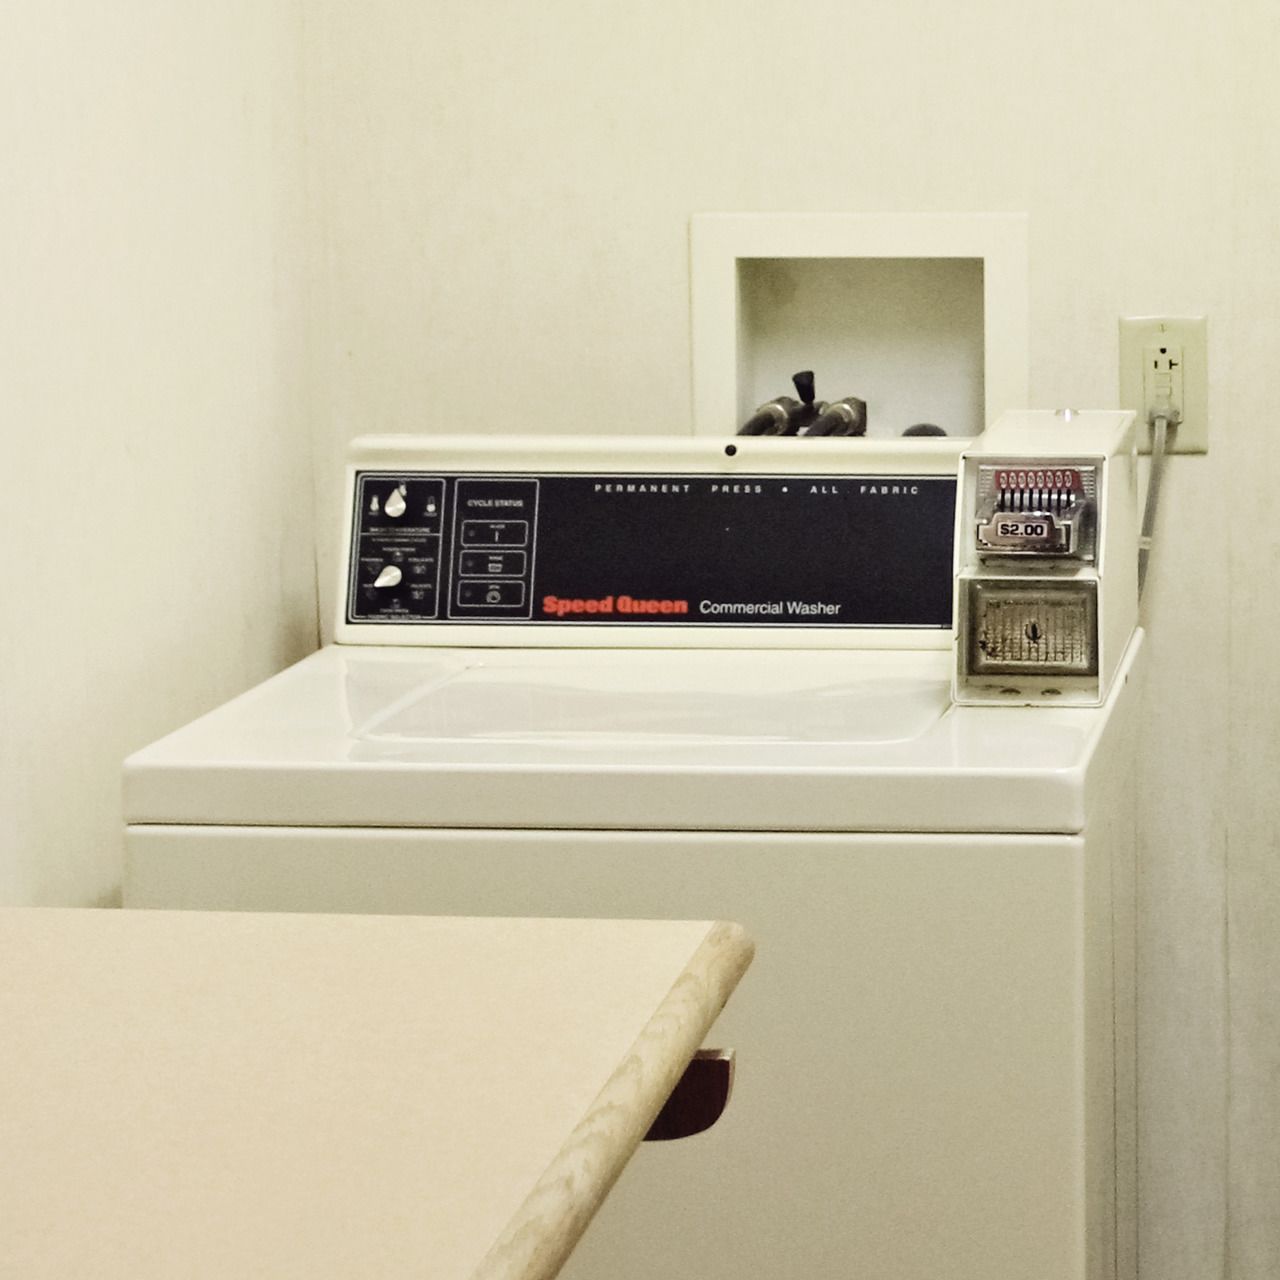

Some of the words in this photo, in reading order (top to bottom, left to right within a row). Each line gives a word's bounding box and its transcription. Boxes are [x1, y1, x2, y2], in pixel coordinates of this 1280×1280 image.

[595, 484, 691, 493] PERMANENT
[711, 485, 763, 493] PRESS
[810, 485, 839, 494] ALL
[860, 486, 919, 494] FABRIC
[467, 499, 493, 507] CYCLE
[494, 499, 524, 507] STATUS
[543, 596, 612, 617] Speed
[617, 596, 688, 614] Queen
[700, 600, 783, 615] Commercial
[787, 601, 841, 615] Washer
